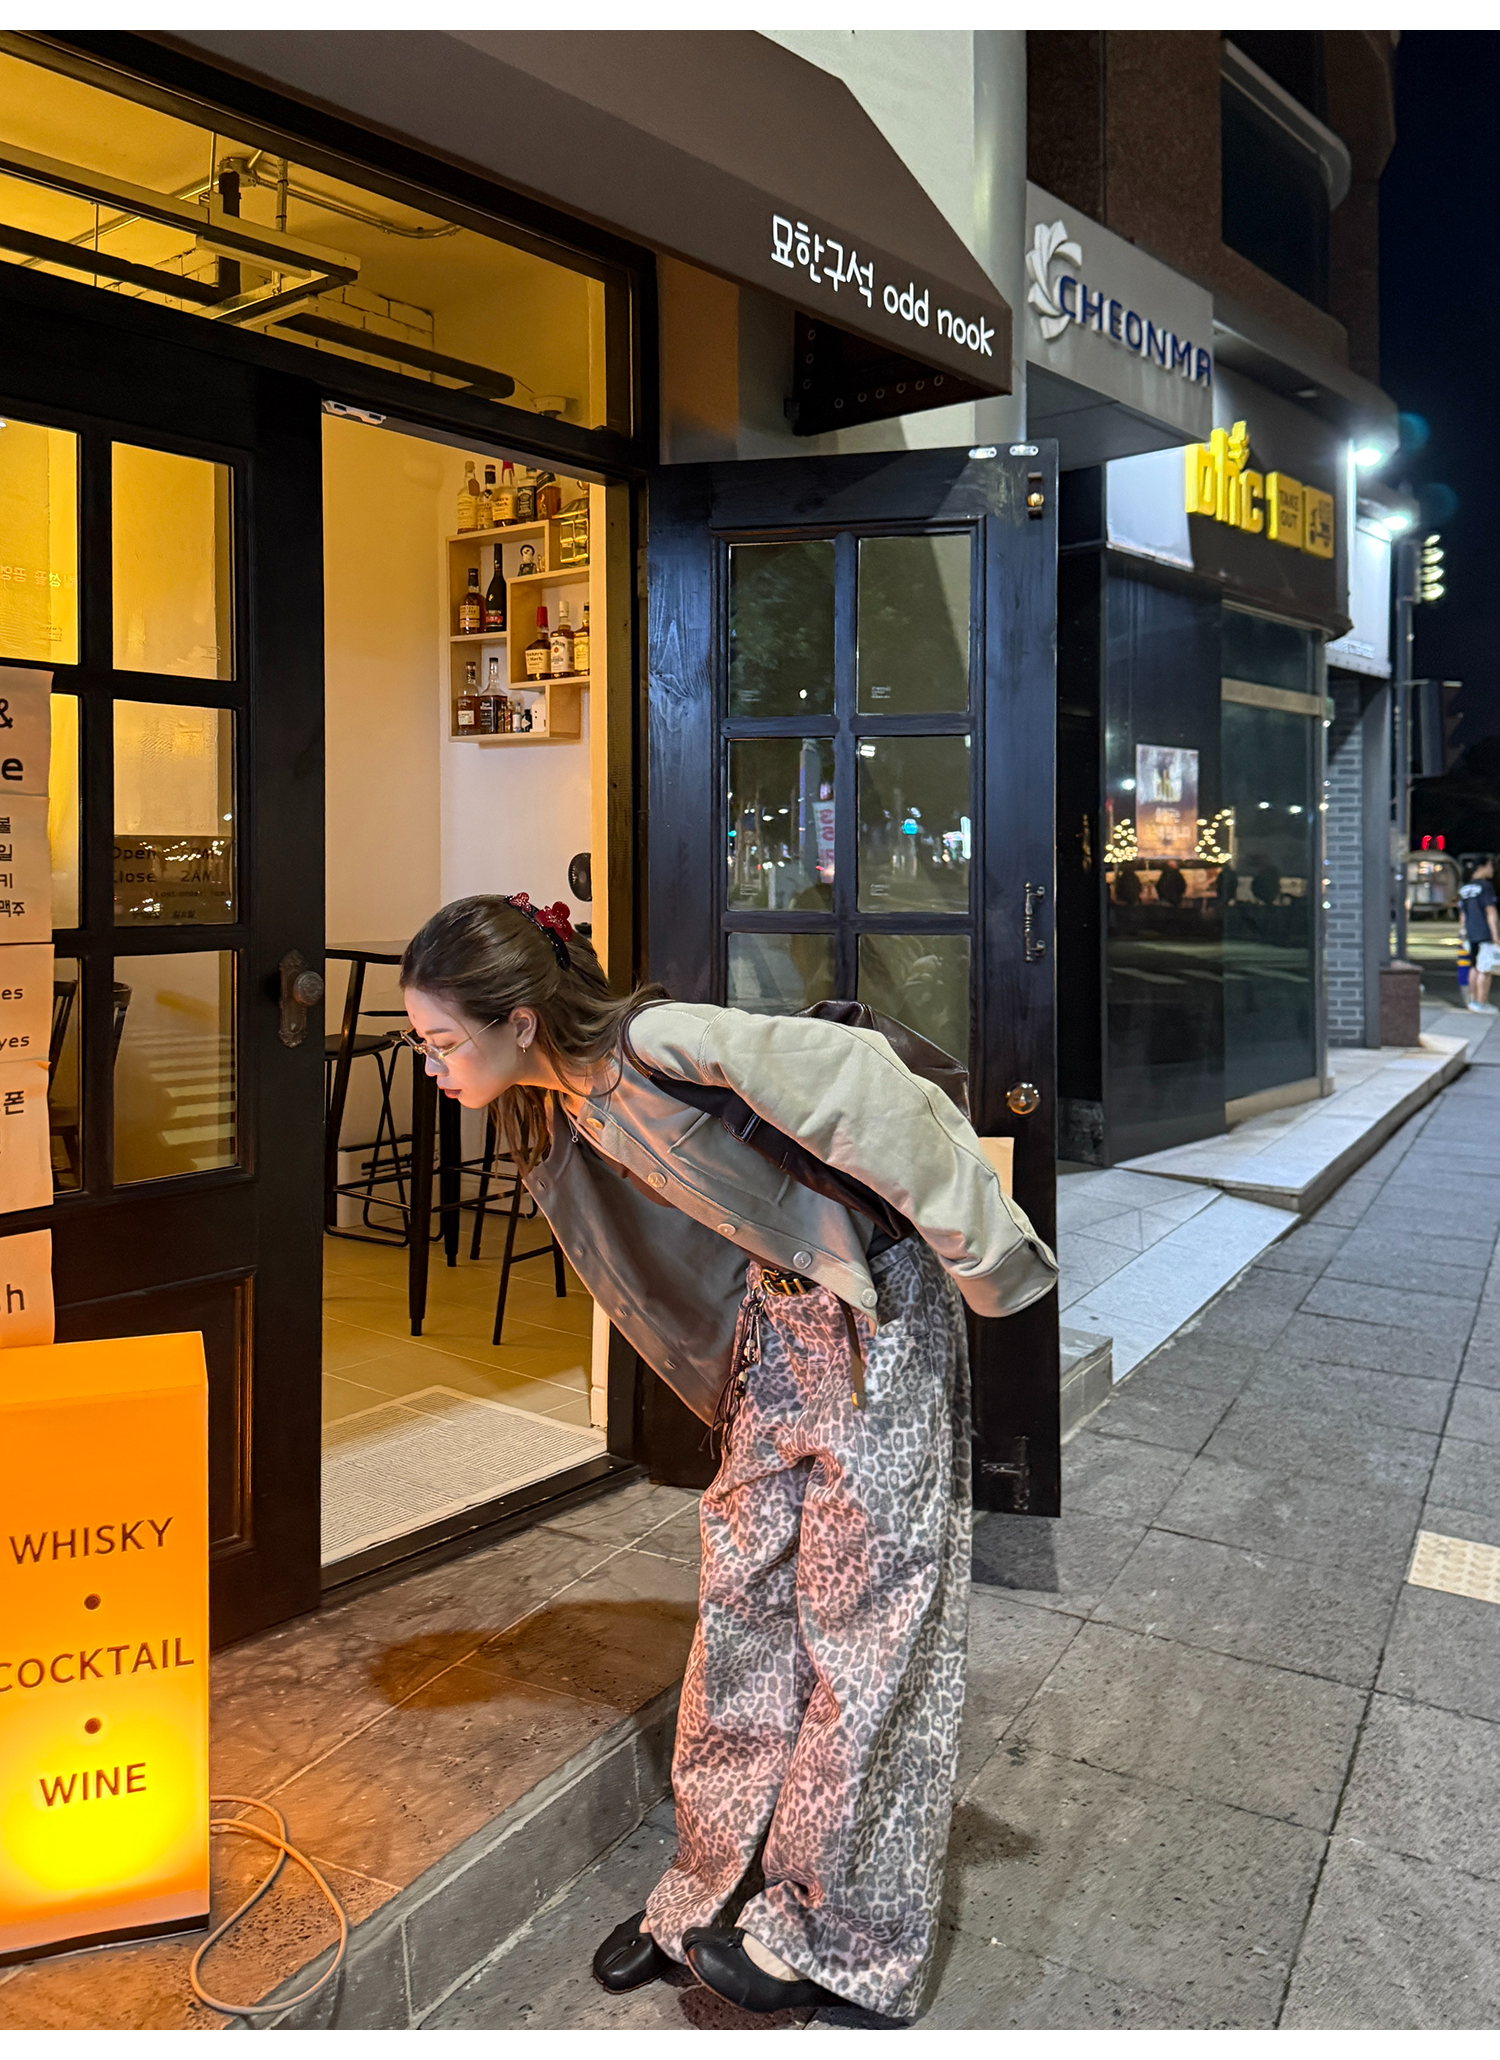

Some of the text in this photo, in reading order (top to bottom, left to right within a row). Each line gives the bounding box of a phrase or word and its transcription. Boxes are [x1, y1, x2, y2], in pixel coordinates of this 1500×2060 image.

[771, 213, 995, 357] 묘한구석 odd nook
[1054, 275, 1211, 387] CHEONMA
[9, 1516, 174, 1565] WHISKY
[0, 1637, 195, 1693] COCKTAIL
[39, 1762, 147, 1807] WINE
